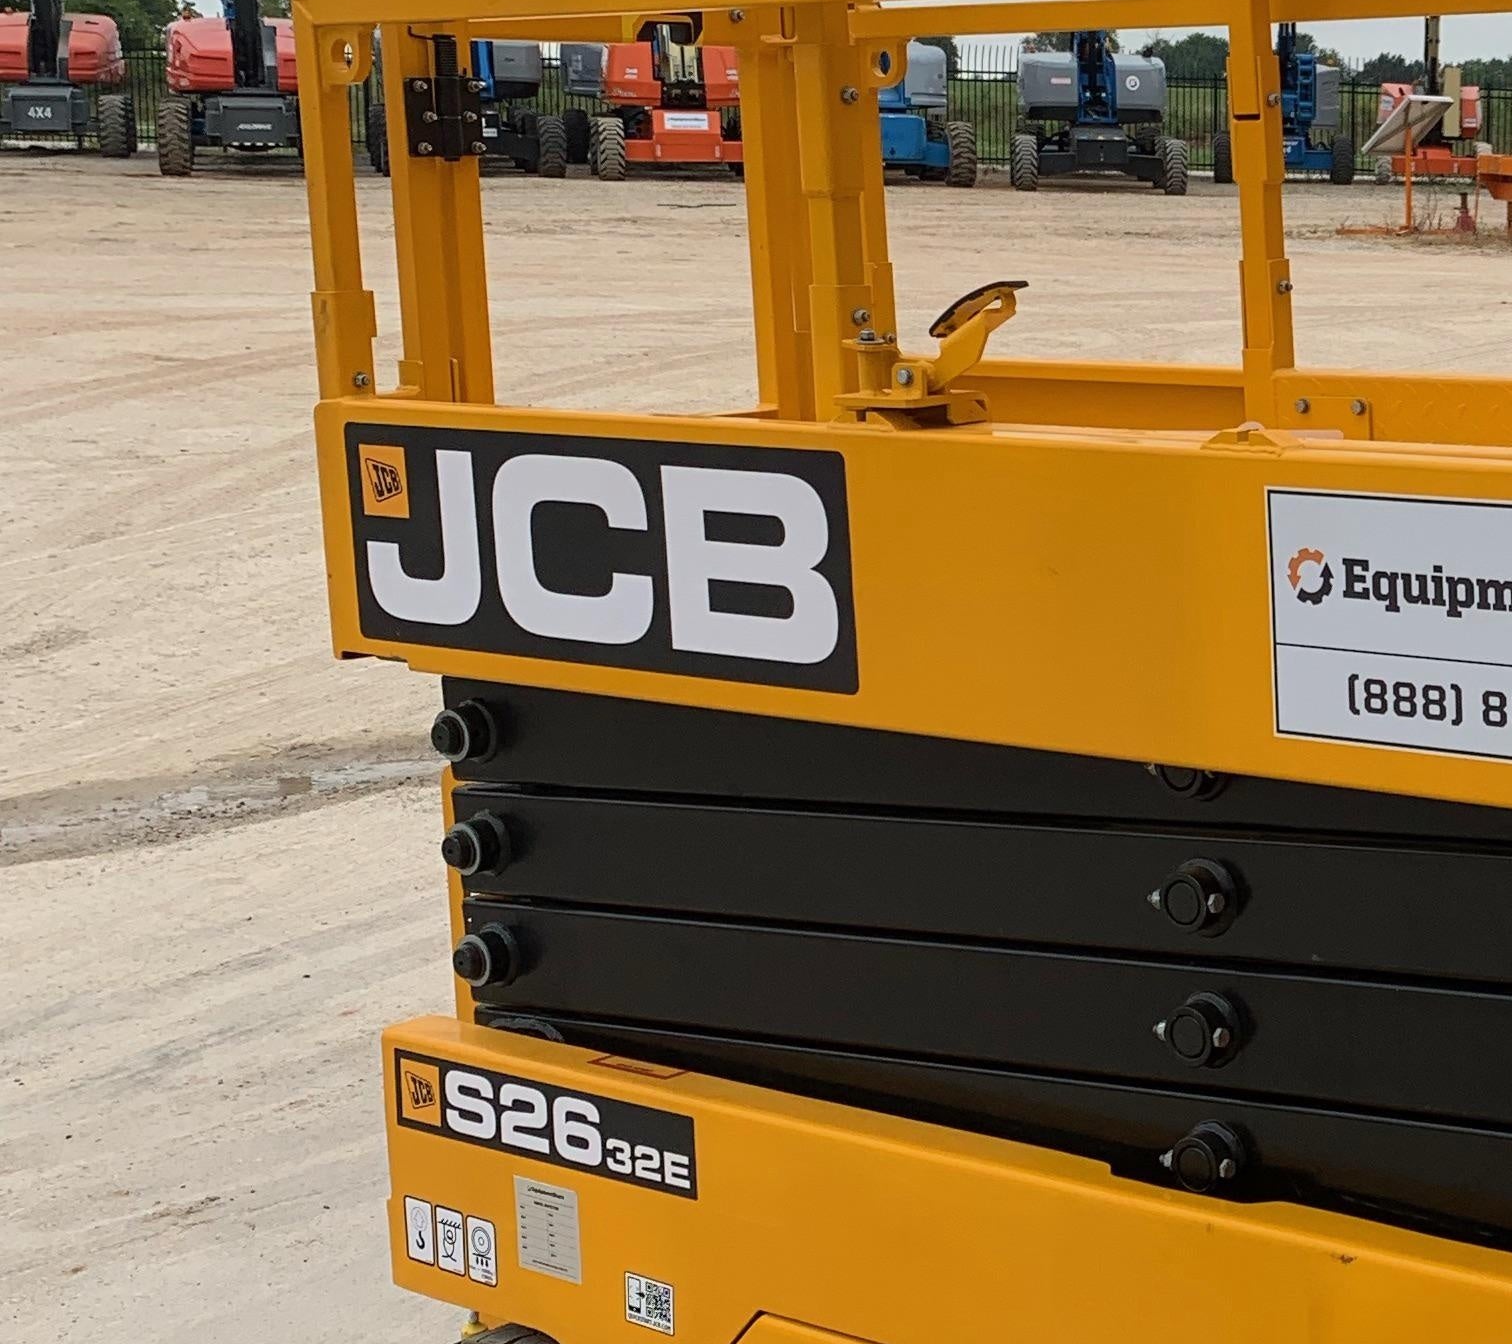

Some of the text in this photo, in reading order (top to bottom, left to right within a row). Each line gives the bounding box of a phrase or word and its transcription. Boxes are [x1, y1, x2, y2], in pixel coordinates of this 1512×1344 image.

[372, 464, 400, 498] JCB
[366, 449, 840, 665] JCB
[1348, 674, 1464, 726] (888)
[409, 1076, 435, 1104] JCB
[444, 1069, 691, 1189] S26 32E
